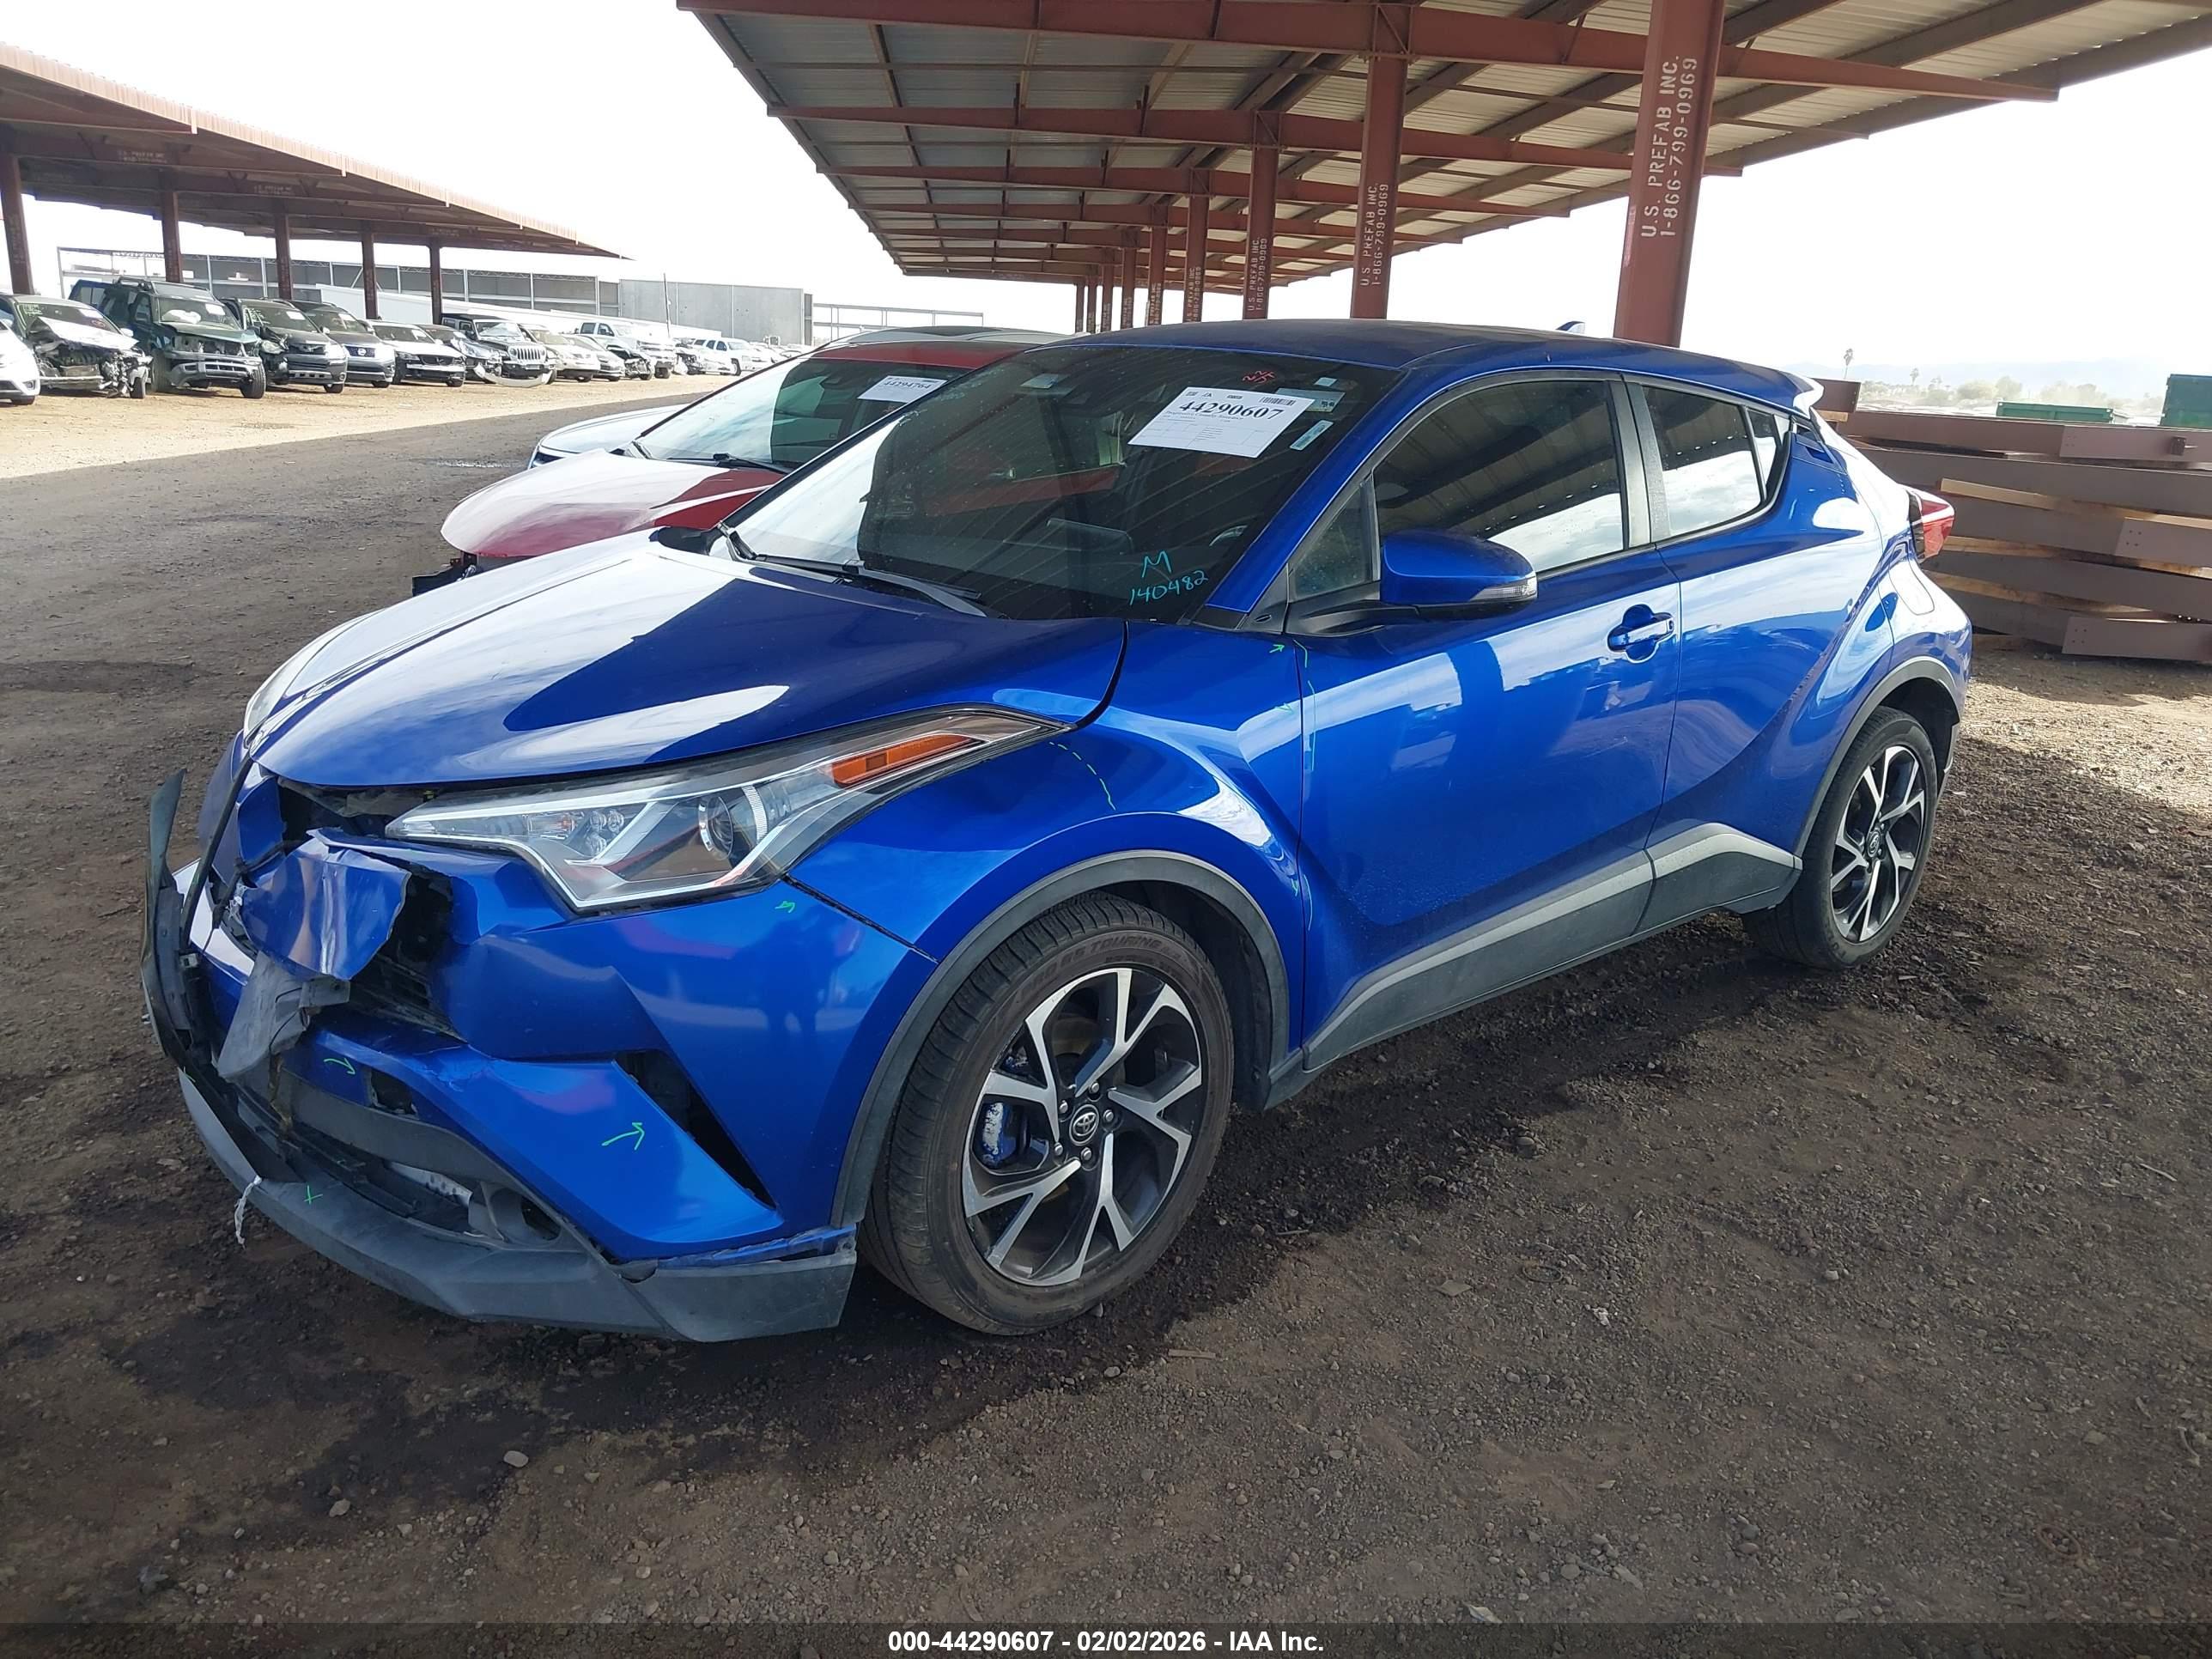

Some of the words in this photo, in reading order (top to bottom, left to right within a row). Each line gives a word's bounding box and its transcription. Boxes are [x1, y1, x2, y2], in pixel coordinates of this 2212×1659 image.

[1659, 56, 1679, 94] INC.
[1648, 106, 1672, 187] PREFAB
[1660, 58, 1698, 236] 1-866-799-0969
[1362, 211, 1376, 257] PREFAB
[1371, 184, 1389, 285] 1-866-799-0969
[1641, 199, 1661, 237] U.S.
[1179, 401, 1285, 420] 44290607
[1141, 550, 1172, 578] M
[1129, 570, 1209, 605] 140482
